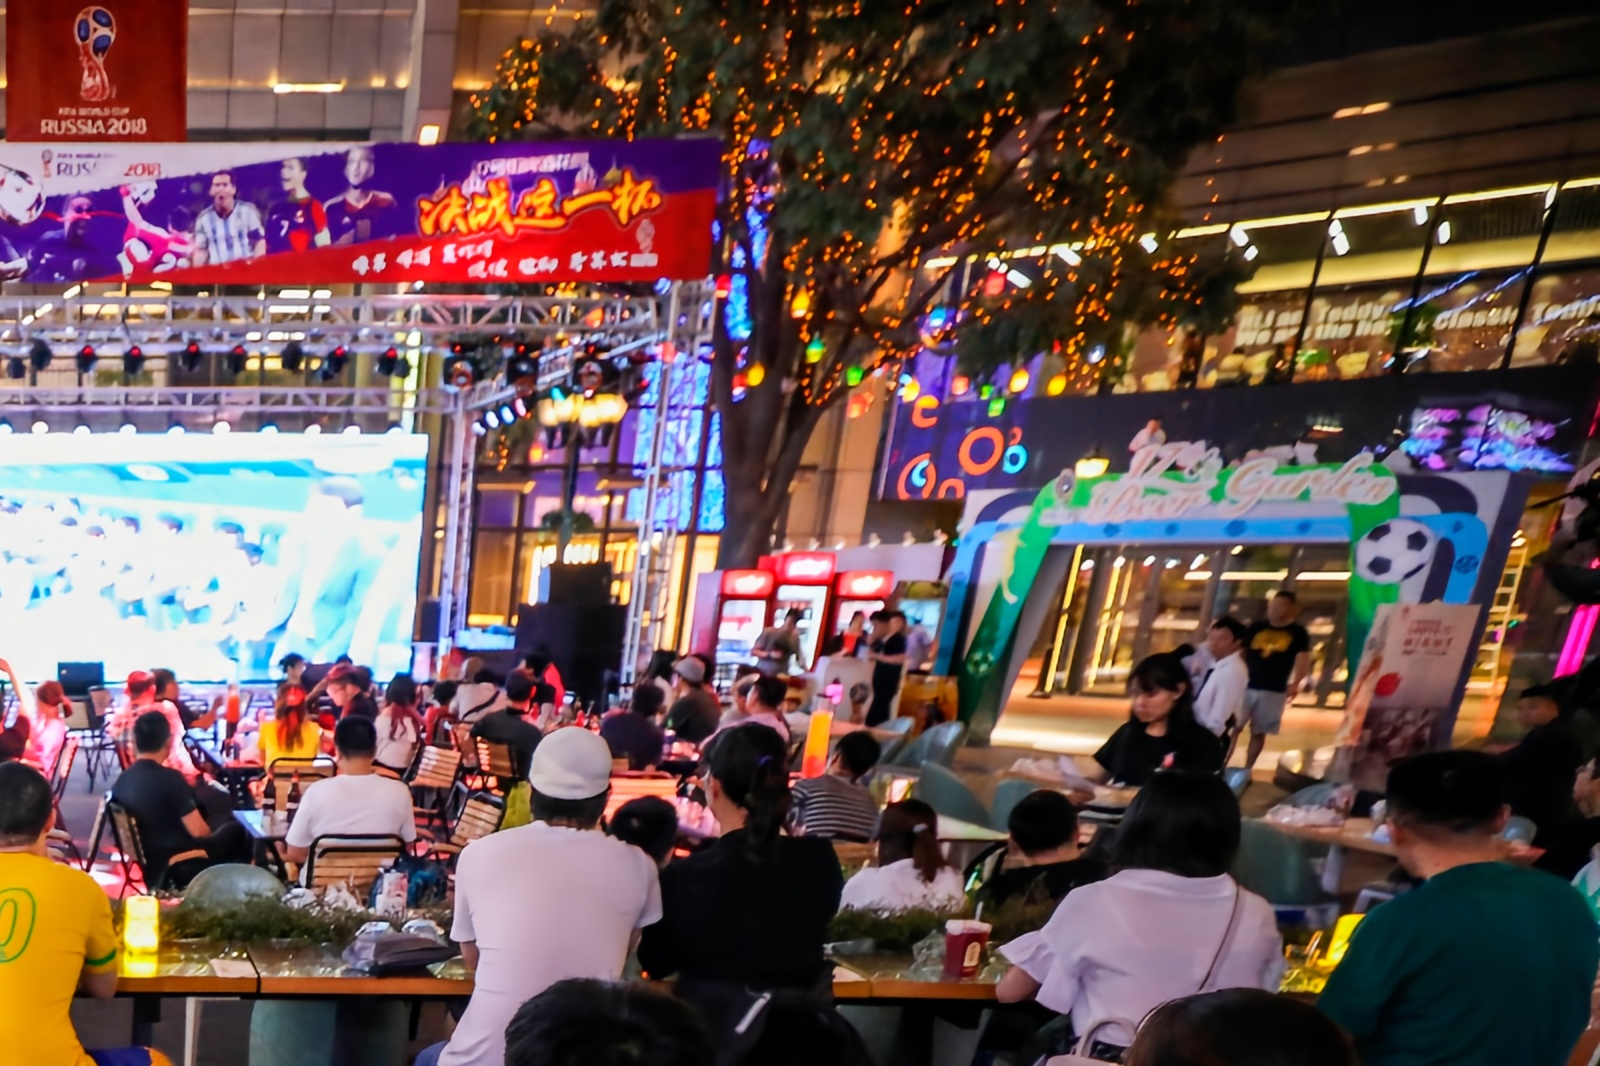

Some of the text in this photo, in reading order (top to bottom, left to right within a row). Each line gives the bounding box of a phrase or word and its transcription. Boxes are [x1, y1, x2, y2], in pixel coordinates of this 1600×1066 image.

[40, 118, 147, 135] RUSSIA 2018
[123, 162, 162, 177] 2018
[1222, 452, 1398, 517] Garden
